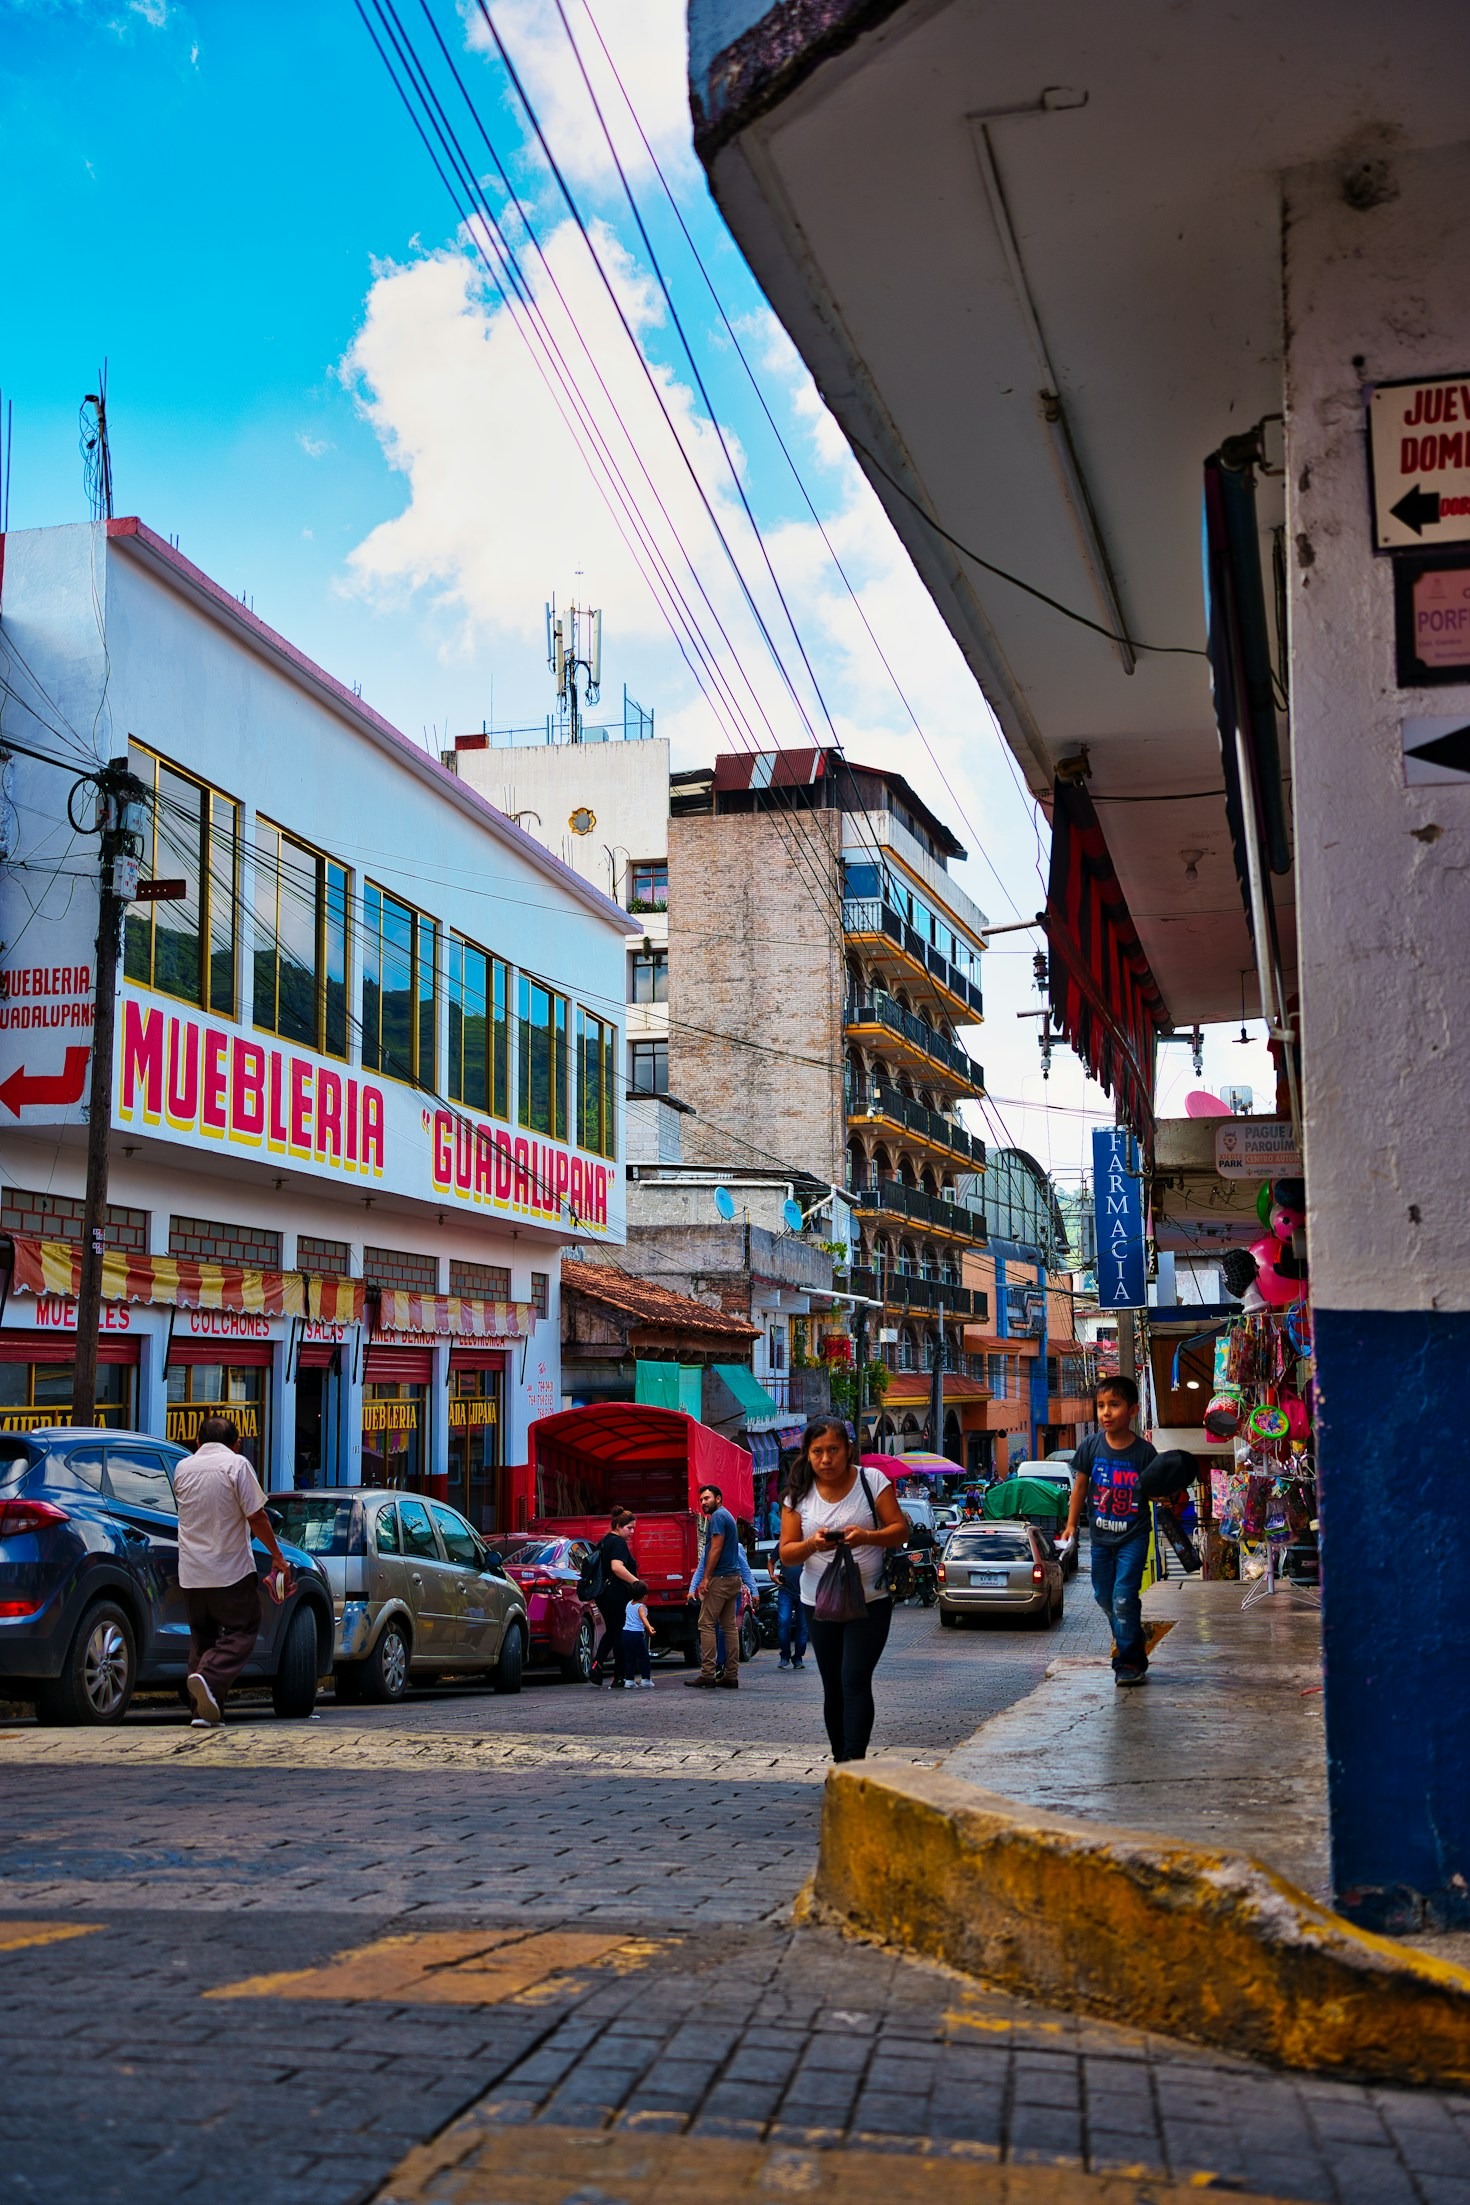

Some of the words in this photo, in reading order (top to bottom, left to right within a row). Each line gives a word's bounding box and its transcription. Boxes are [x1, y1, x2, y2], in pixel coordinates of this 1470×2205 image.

[119, 1000, 384, 1179] MUEBLERIA
[1245, 1126, 1286, 1139] PAGUE
[1219, 1160, 1243, 1168] PARK
[1246, 1154, 1274, 1163] CENTRO
[1106, 1133, 1131, 1300] FARMACIA
[36, 1298, 131, 1330] MUEES
[190, 1308, 270, 1337] COLCHONES
[306, 1320, 344, 1341] SALAS
[1113, 1469, 1139, 1487] NYC
